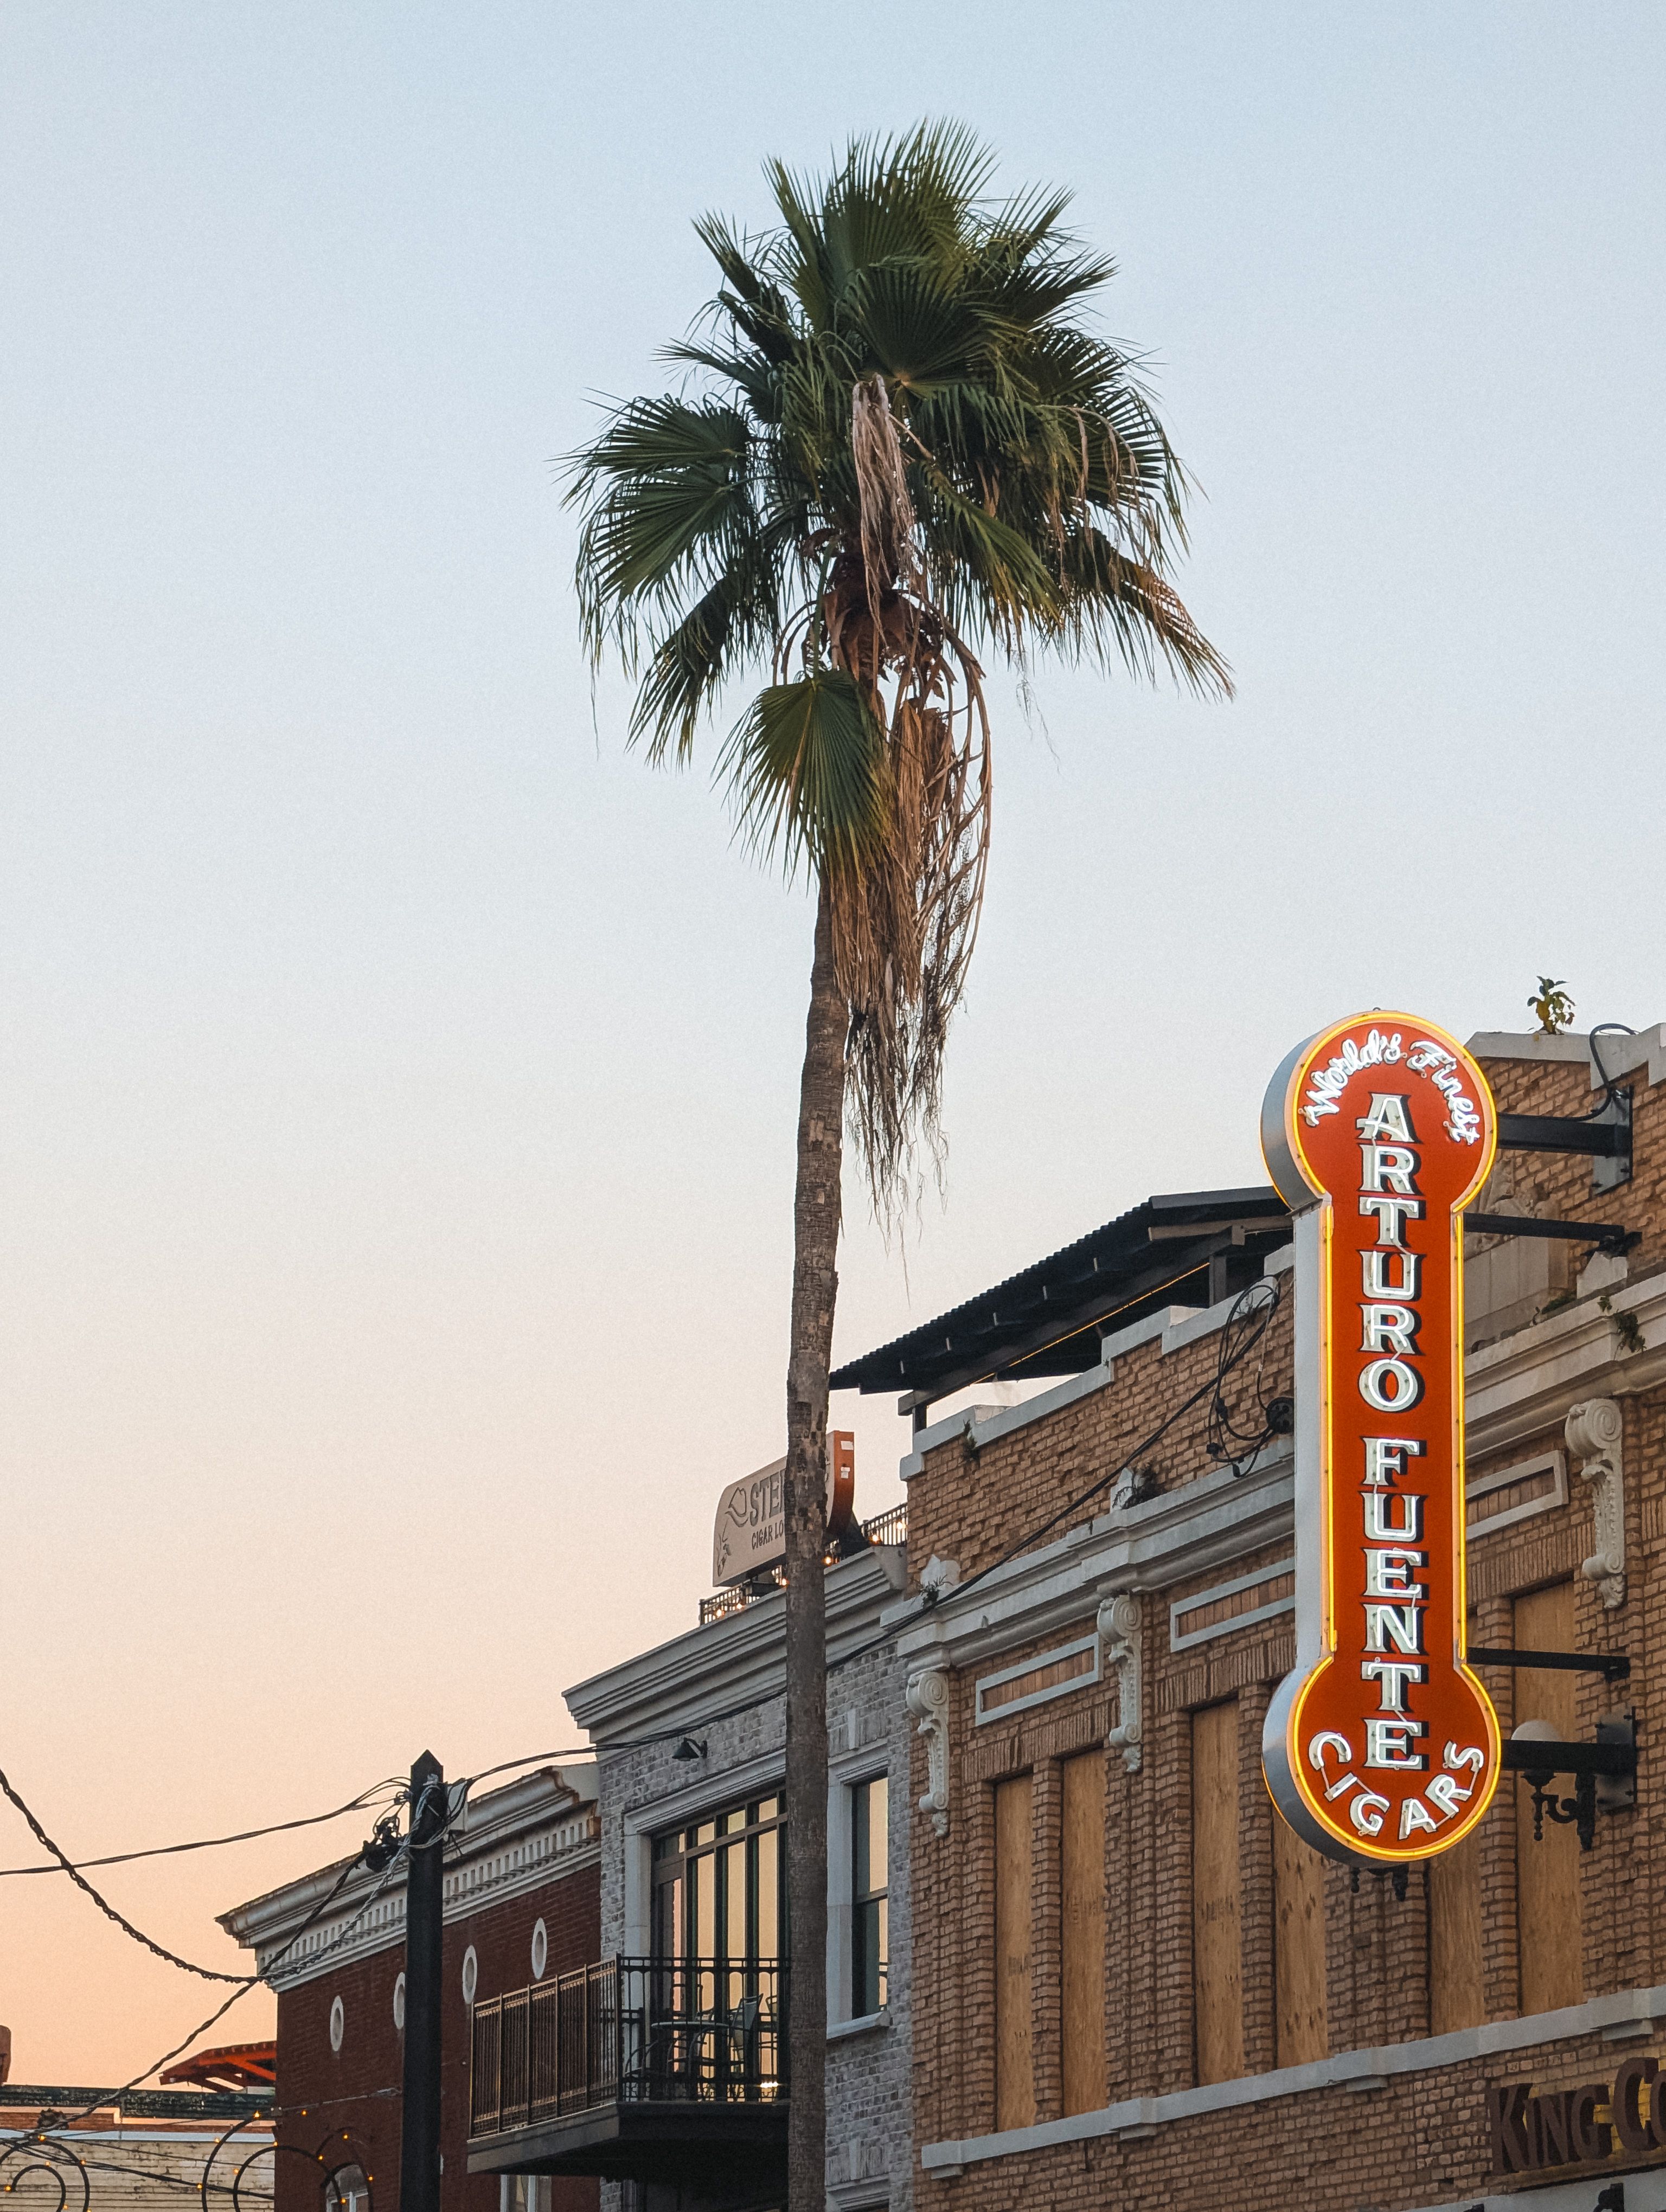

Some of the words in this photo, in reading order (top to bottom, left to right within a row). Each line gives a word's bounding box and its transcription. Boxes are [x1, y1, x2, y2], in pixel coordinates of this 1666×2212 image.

[1303, 1029, 1402, 1127] World's
[1407, 1040, 1481, 1145] Finest
[1357, 1092, 1426, 1412] ARTURO
[1360, 1436, 1429, 1770] FUENTE
[1308, 1731, 1484, 1840] CIGARS
[1487, 2083, 1612, 2176] KING
